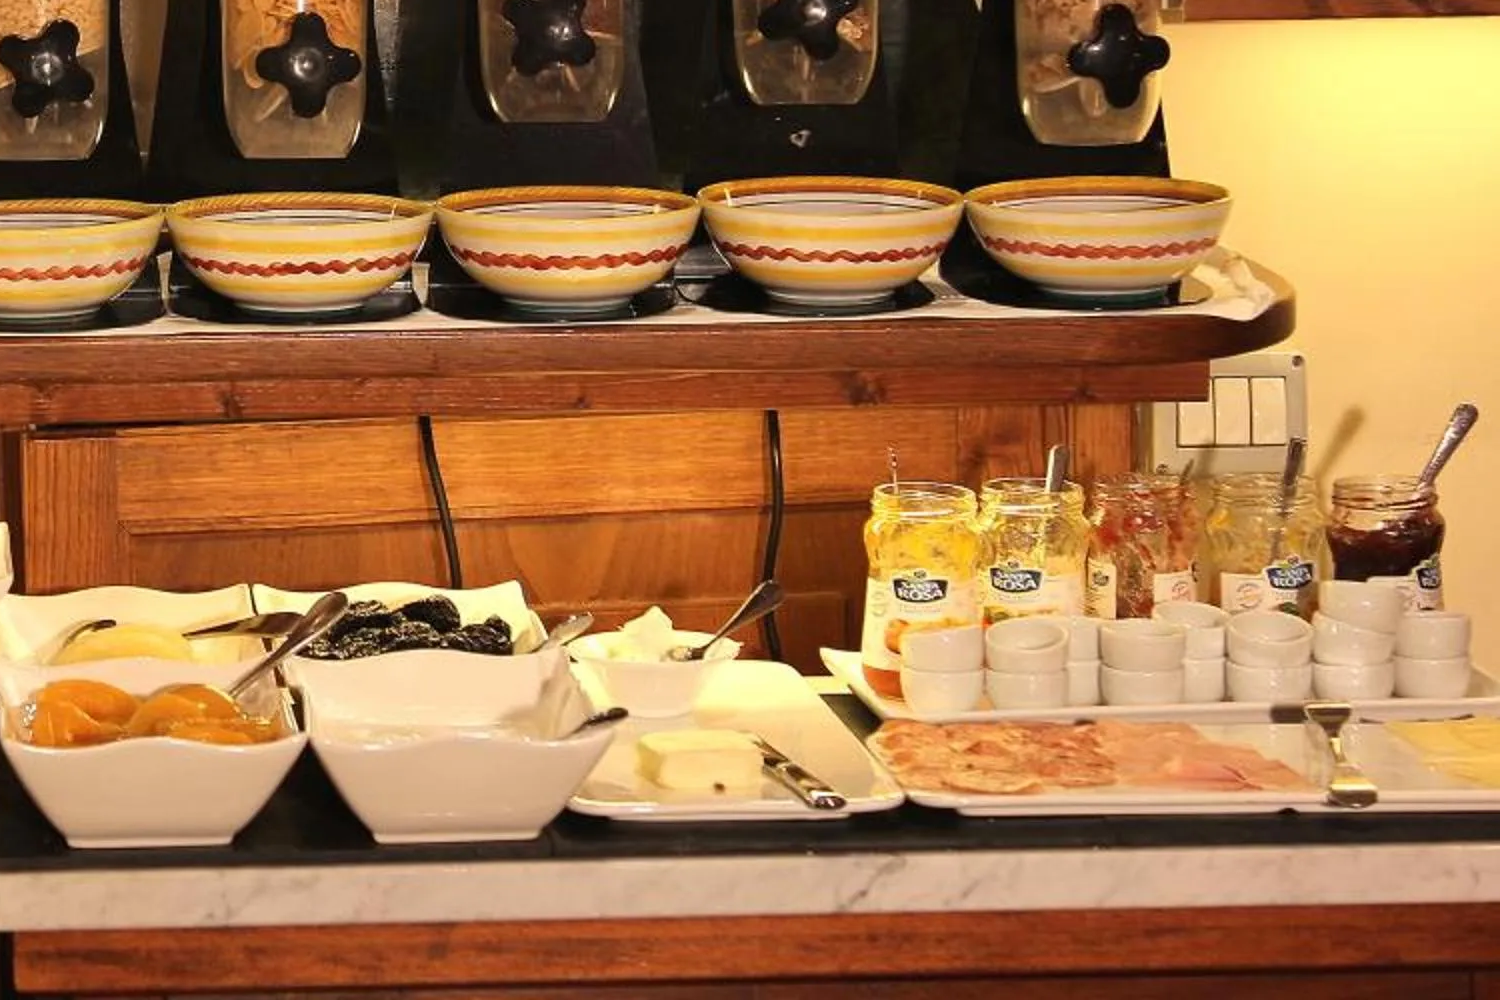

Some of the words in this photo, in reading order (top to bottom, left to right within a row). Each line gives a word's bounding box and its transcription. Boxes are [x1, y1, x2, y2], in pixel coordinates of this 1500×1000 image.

[995, 571, 1033, 581] SANTA
[900, 581, 940, 590] SANTA
[996, 578, 1037, 590] ROSA
[897, 587, 944, 601] ROSA
